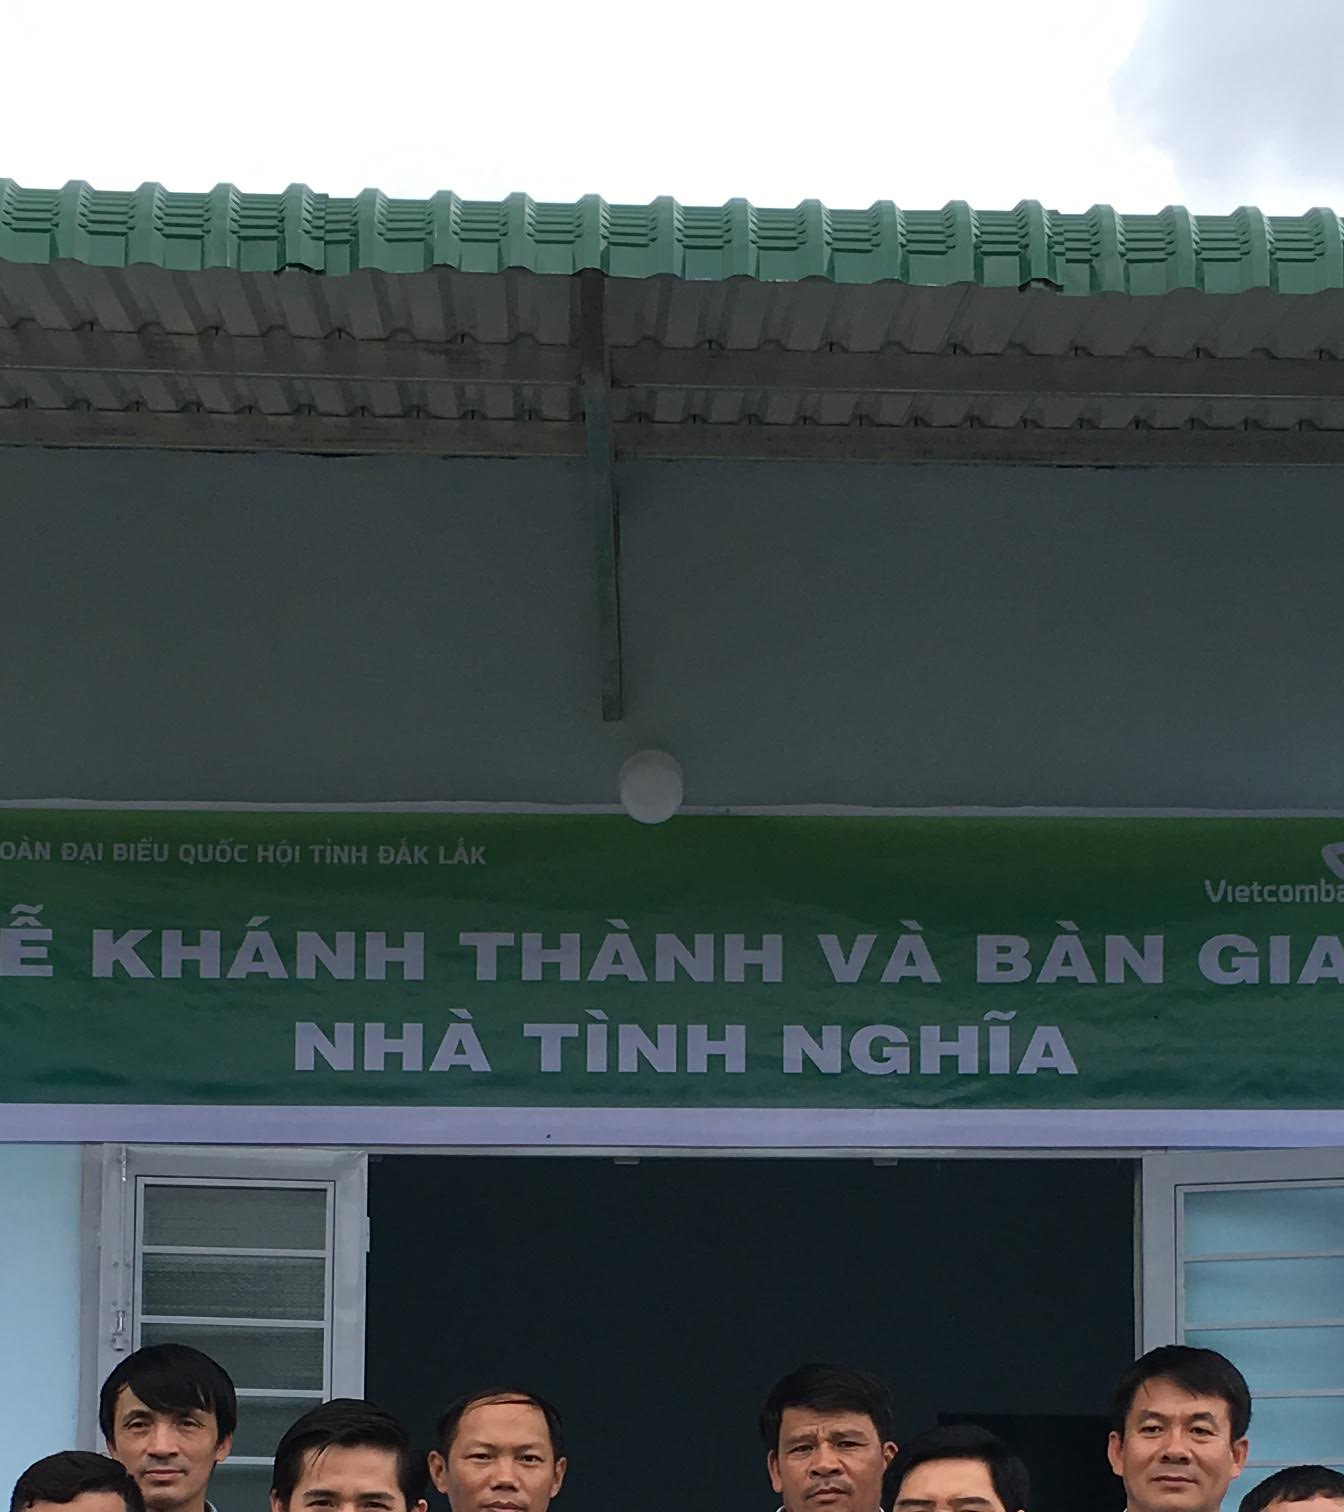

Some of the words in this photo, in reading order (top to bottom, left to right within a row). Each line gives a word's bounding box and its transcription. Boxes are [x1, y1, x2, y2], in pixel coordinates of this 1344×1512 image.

[60, 842, 104, 864] ĐẠI
[113, 836, 169, 862] BIỂU
[178, 838, 248, 865] QUỐC
[257, 839, 300, 867] HỘI
[309, 839, 368, 864] TỈNH
[377, 837, 429, 865] ĐẮK
[438, 837, 486, 865] LẮK
[91, 916, 425, 980] KHÁNH
[459, 918, 784, 983] THÀNH
[818, 919, 941, 984] VÀ
[976, 920, 1164, 985] BÀN
[294, 1008, 491, 1072] NHÀ
[523, 1009, 747, 1074] TÌNH
[782, 1010, 1078, 1076] NGHĨA
